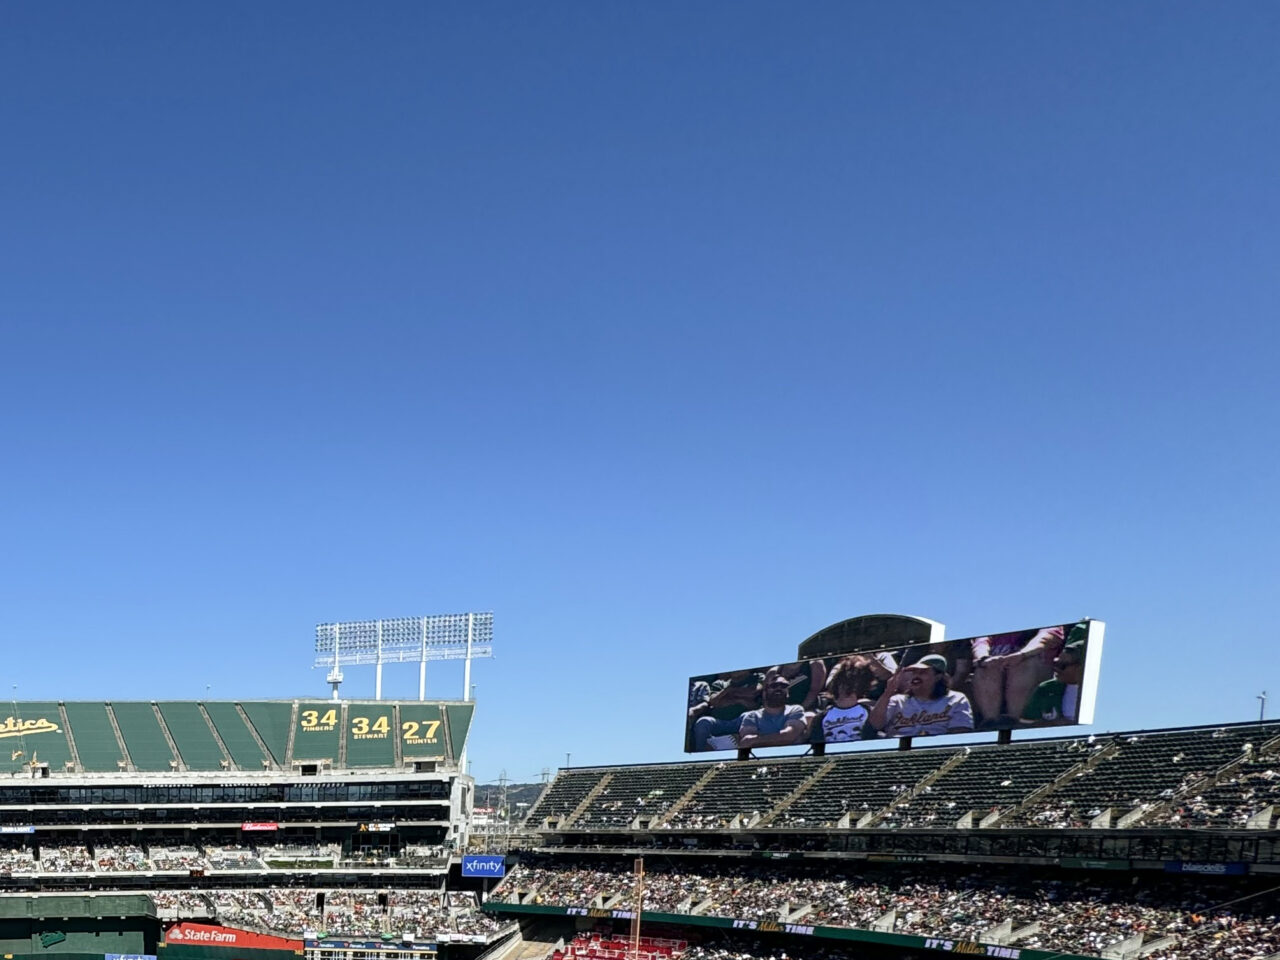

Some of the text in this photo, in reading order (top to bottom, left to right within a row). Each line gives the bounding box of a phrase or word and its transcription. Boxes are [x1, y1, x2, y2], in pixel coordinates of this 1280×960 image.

[301, 709, 338, 727] 34
[352, 716, 390, 734] 34
[894, 706, 952, 728] Oakland
[402, 721, 441, 739] 27
[466, 860, 501, 872] xfinity
[566, 908, 588, 916] IT'S
[184, 929, 236, 943] State Farm
[733, 920, 758, 929] IT'S
[785, 924, 815, 935] TIME
[925, 939, 1021, 959] IT'S Miller TIME
